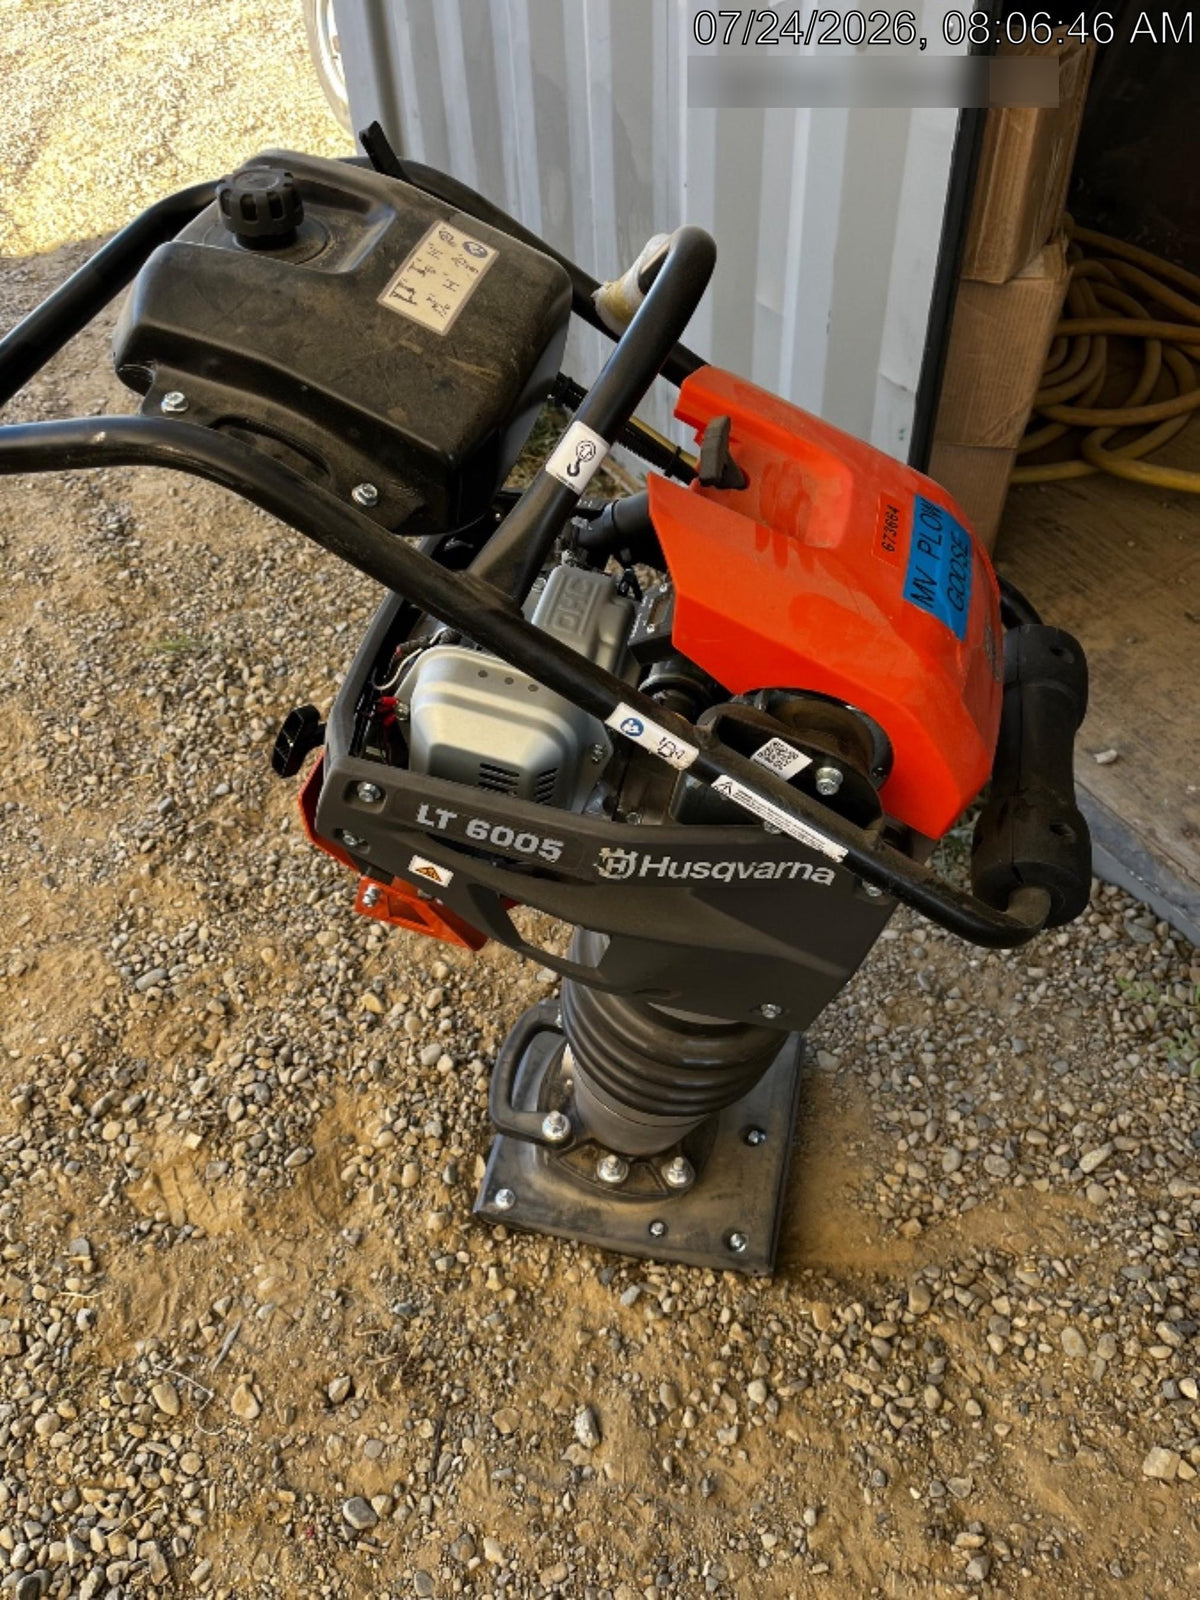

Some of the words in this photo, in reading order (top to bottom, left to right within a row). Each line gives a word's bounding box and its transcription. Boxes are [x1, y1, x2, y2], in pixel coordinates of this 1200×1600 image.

[881, 504, 900, 552] 673664
[917, 497, 943, 561] PLOW
[910, 565, 938, 609] MV
[947, 531, 969, 613] GOOSE
[416, 803, 457, 830] LT
[465, 818, 565, 863] 6005
[639, 855, 836, 886] Husqvarna
